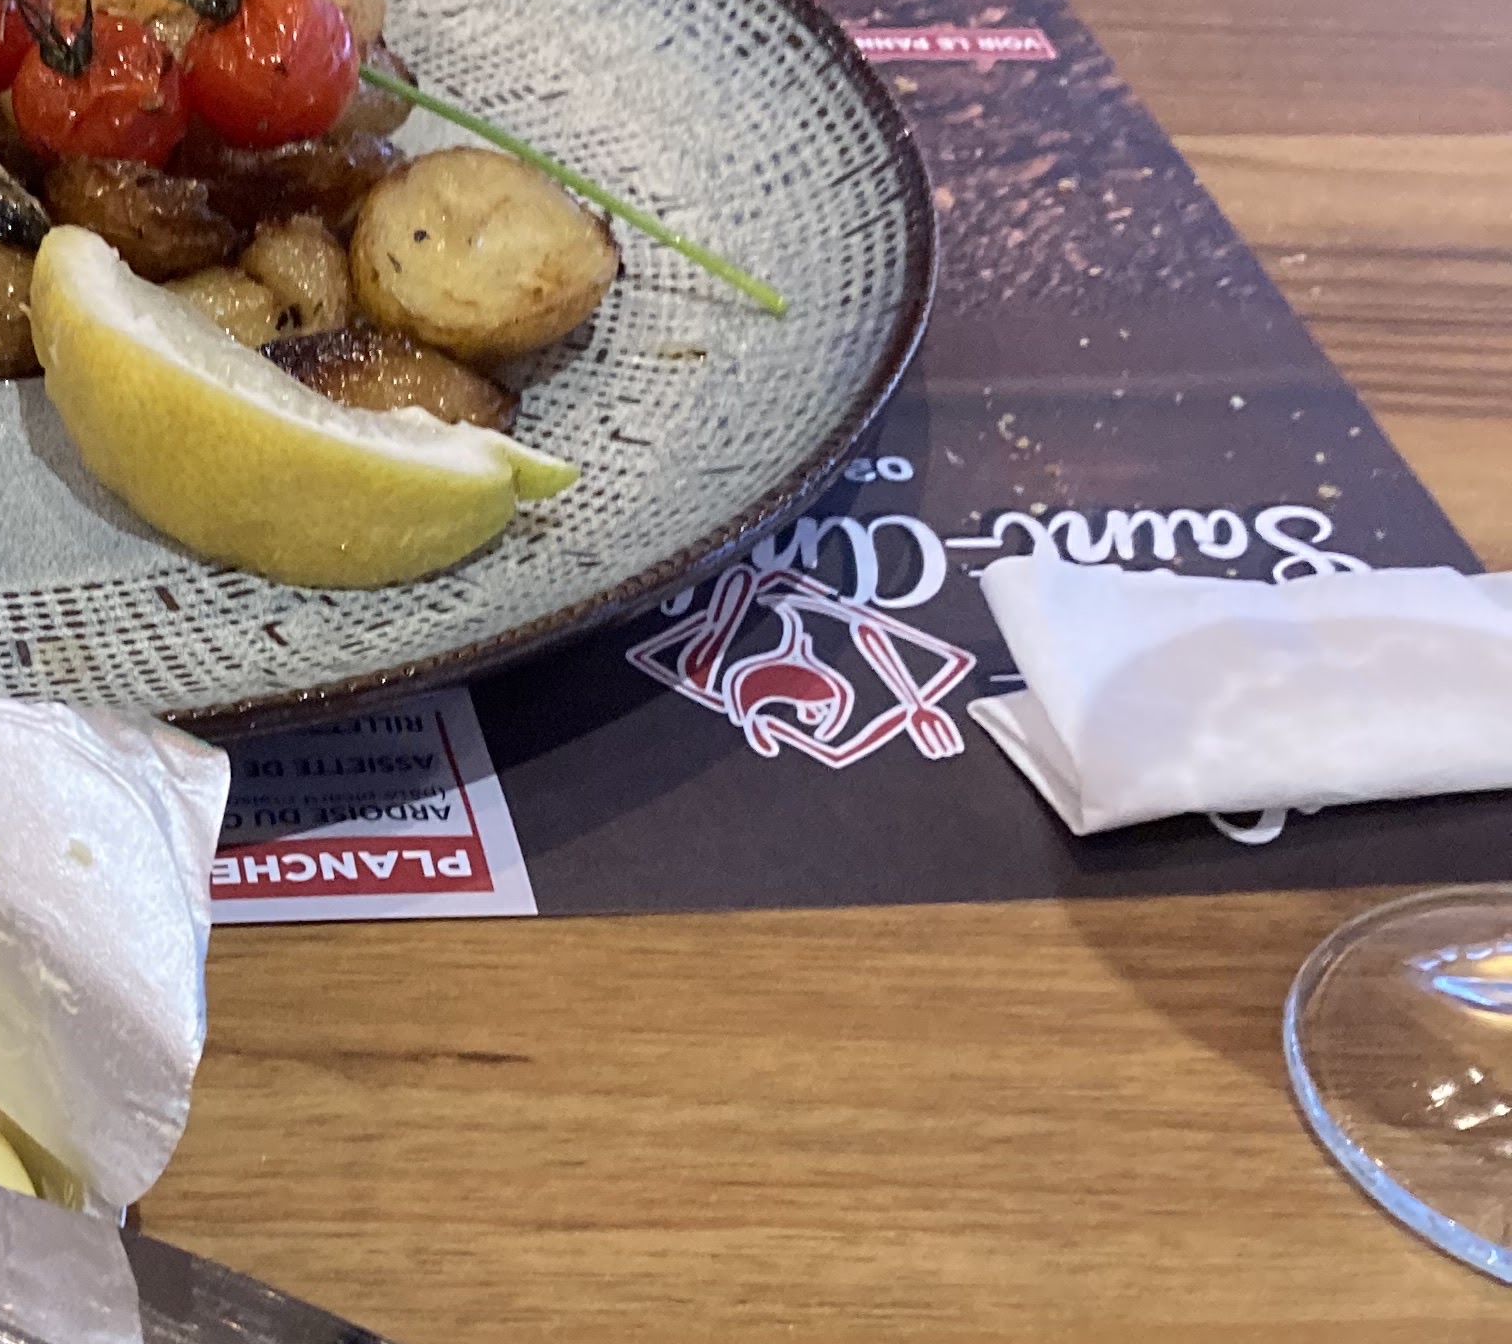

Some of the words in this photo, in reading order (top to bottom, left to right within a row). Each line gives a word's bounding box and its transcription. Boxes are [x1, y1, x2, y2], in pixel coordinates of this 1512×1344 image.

[243, 758, 283, 779] DE
[294, 753, 433, 778] ASSIETTE
[254, 808, 301, 826] DU
[317, 803, 450, 823] ARDOISE
[213, 849, 472, 885] PLANCHE
